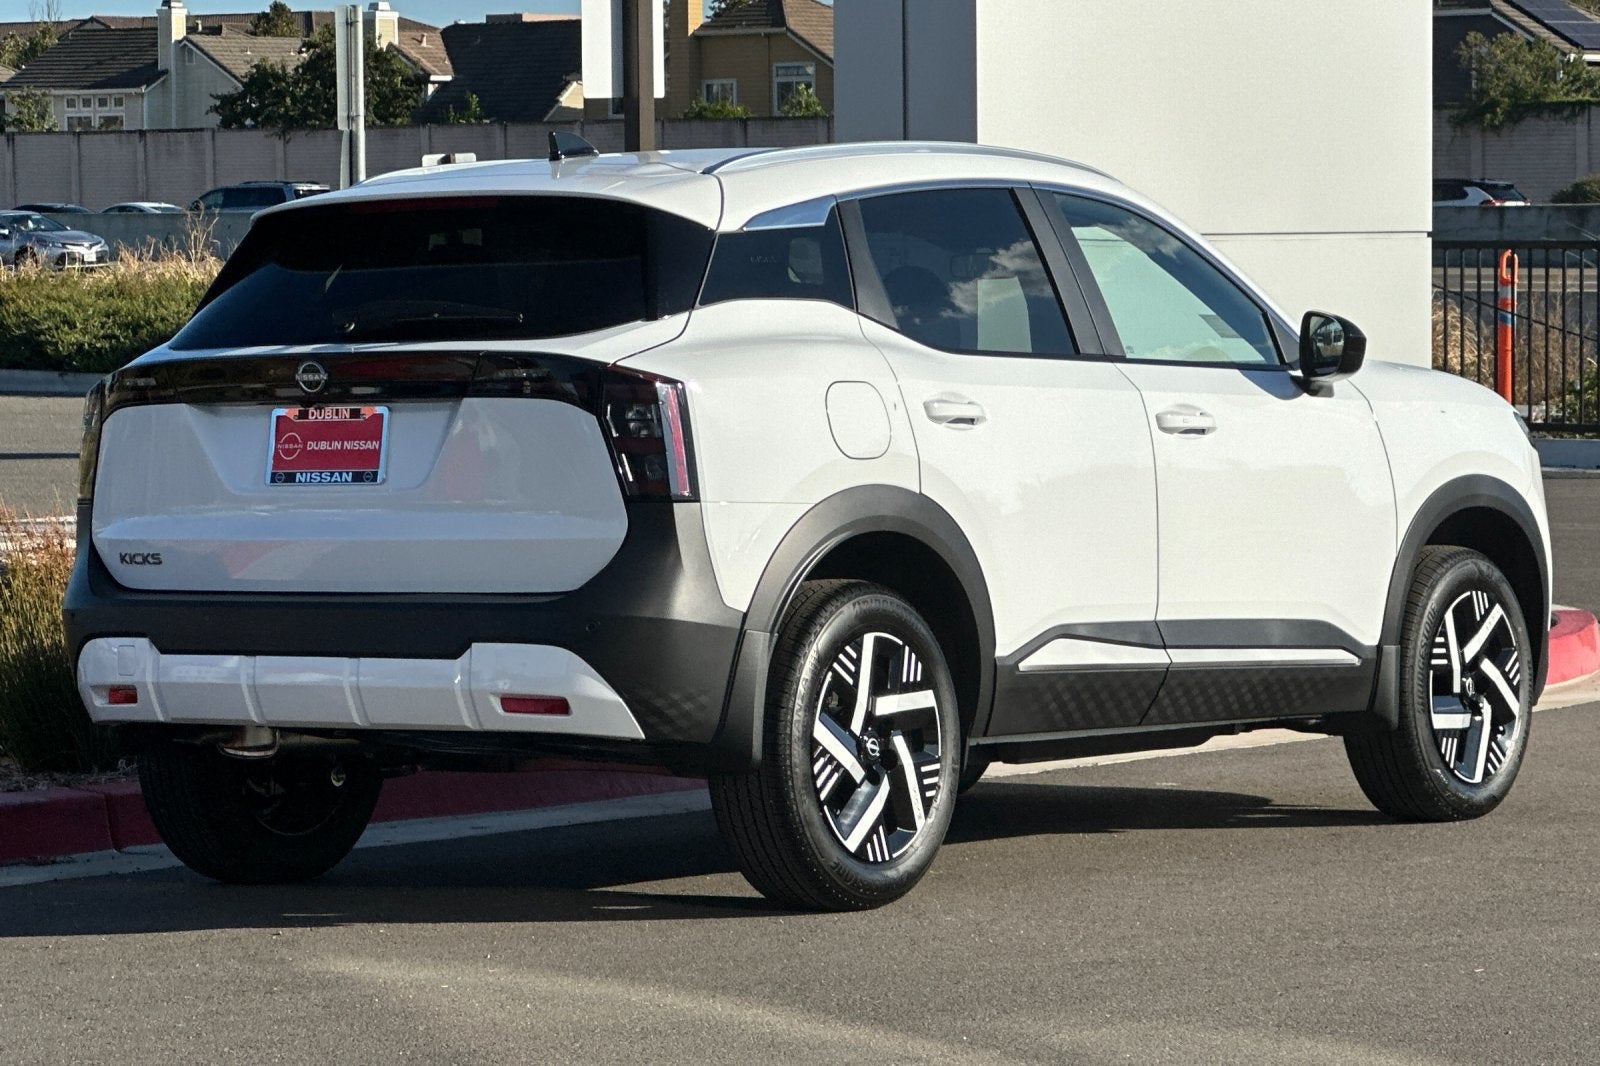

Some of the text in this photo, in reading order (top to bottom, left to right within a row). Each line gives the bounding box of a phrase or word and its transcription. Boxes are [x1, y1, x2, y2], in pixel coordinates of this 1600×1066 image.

[295, 373, 328, 381] NISSAN
[308, 408, 350, 419] DUBLIN
[307, 440, 379, 450] DUBLIN NISSAN
[295, 472, 352, 483] NISSAN
[119, 552, 163, 565] KICKS
